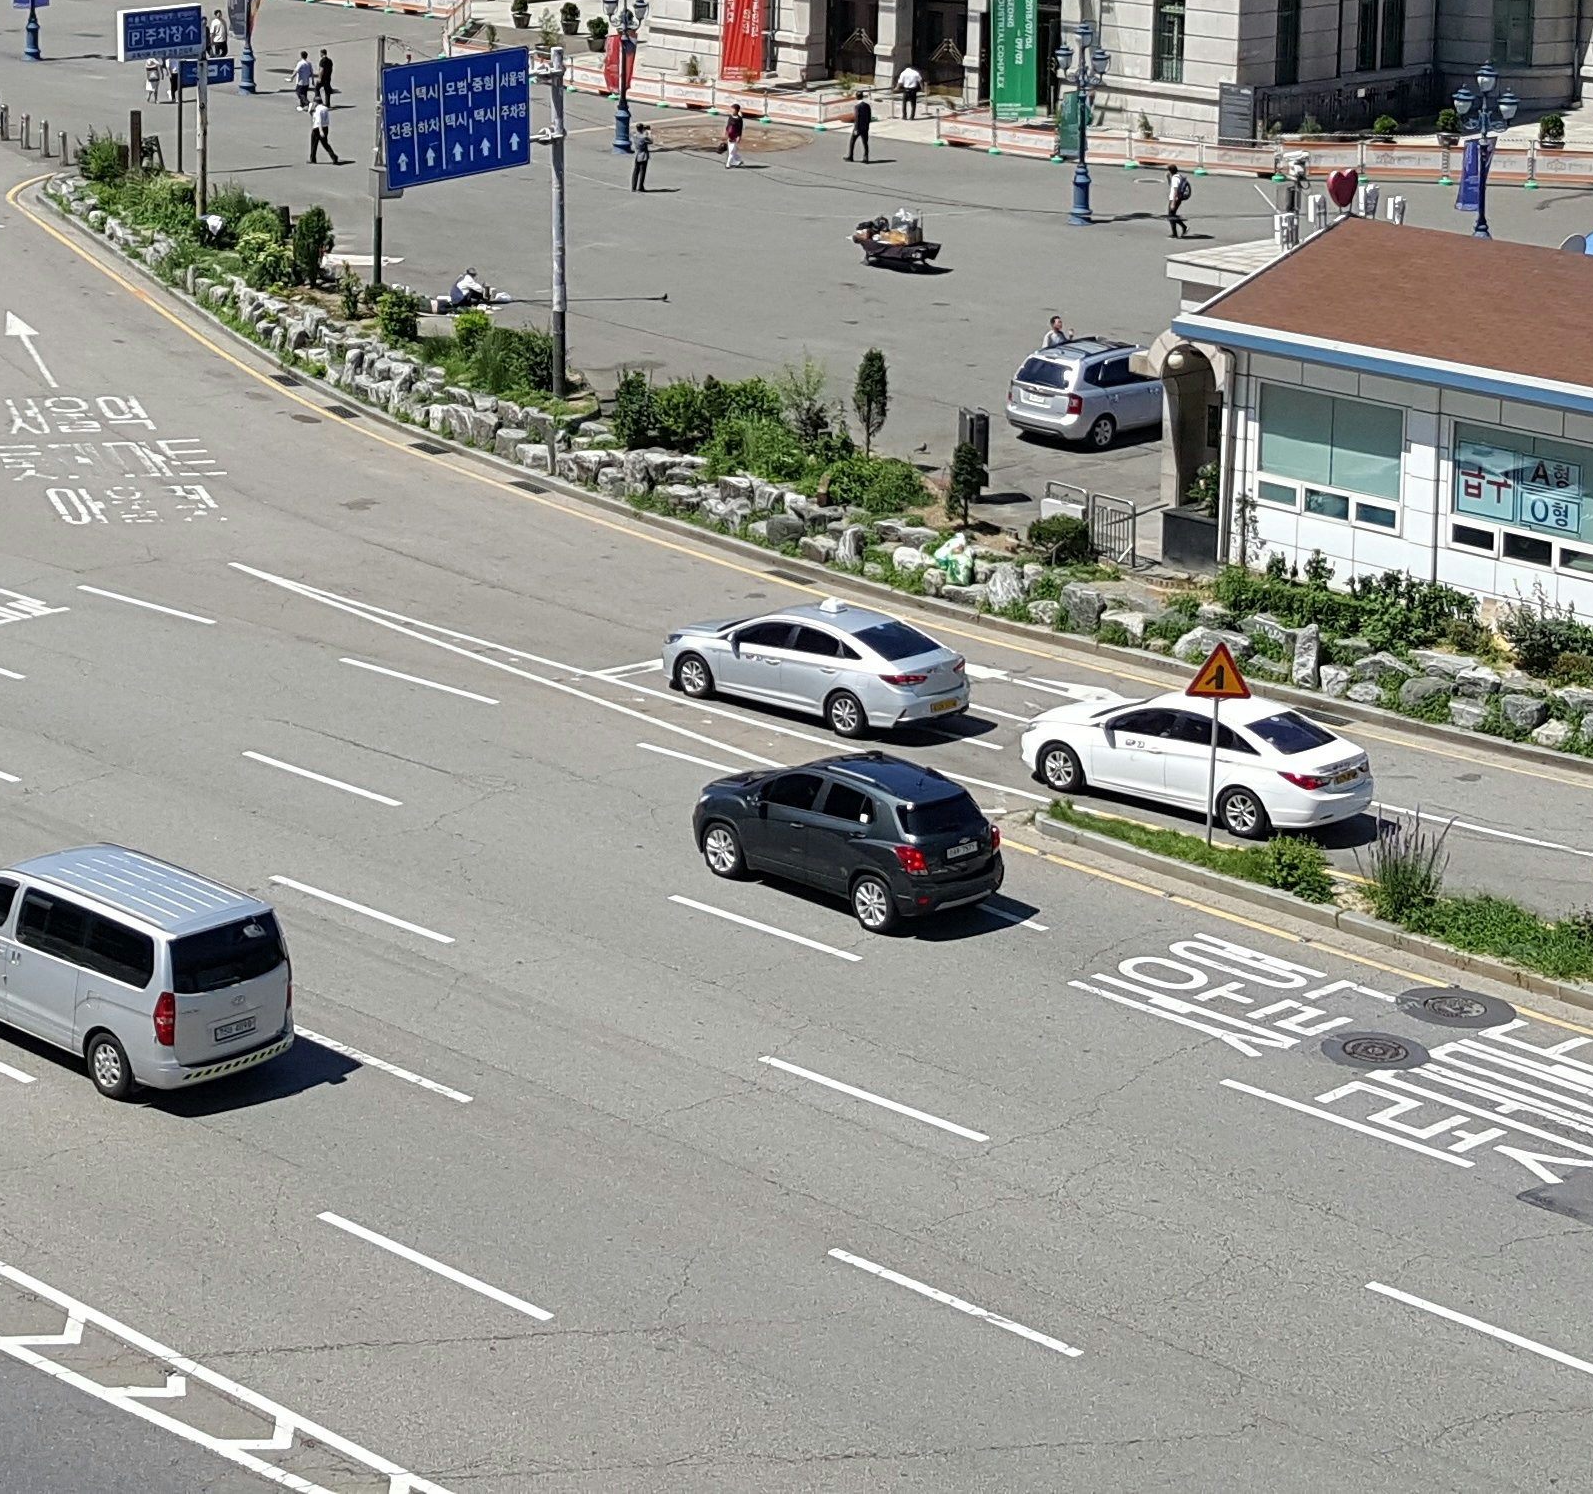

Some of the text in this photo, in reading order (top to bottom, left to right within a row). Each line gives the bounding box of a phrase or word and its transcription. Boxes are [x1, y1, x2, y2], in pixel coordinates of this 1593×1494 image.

[145, 25, 183, 45] 주차장
[996, 45, 1006, 89] COMPLEX
[444, 80, 468, 96] 모범
[471, 75, 494, 92] 중형
[500, 70, 526, 88] 서울역
[387, 90, 412, 106] 버스
[416, 84, 438, 101] 택시
[445, 111, 468, 129] 택시
[474, 106, 496, 123] 택시
[500, 102, 527, 120] 주차장
[389, 122, 413, 140] 전용
[417, 117, 440, 135] 하차
[4, 395, 158, 435] 서울역
[1067, 932, 1398, 1059] 서울역
